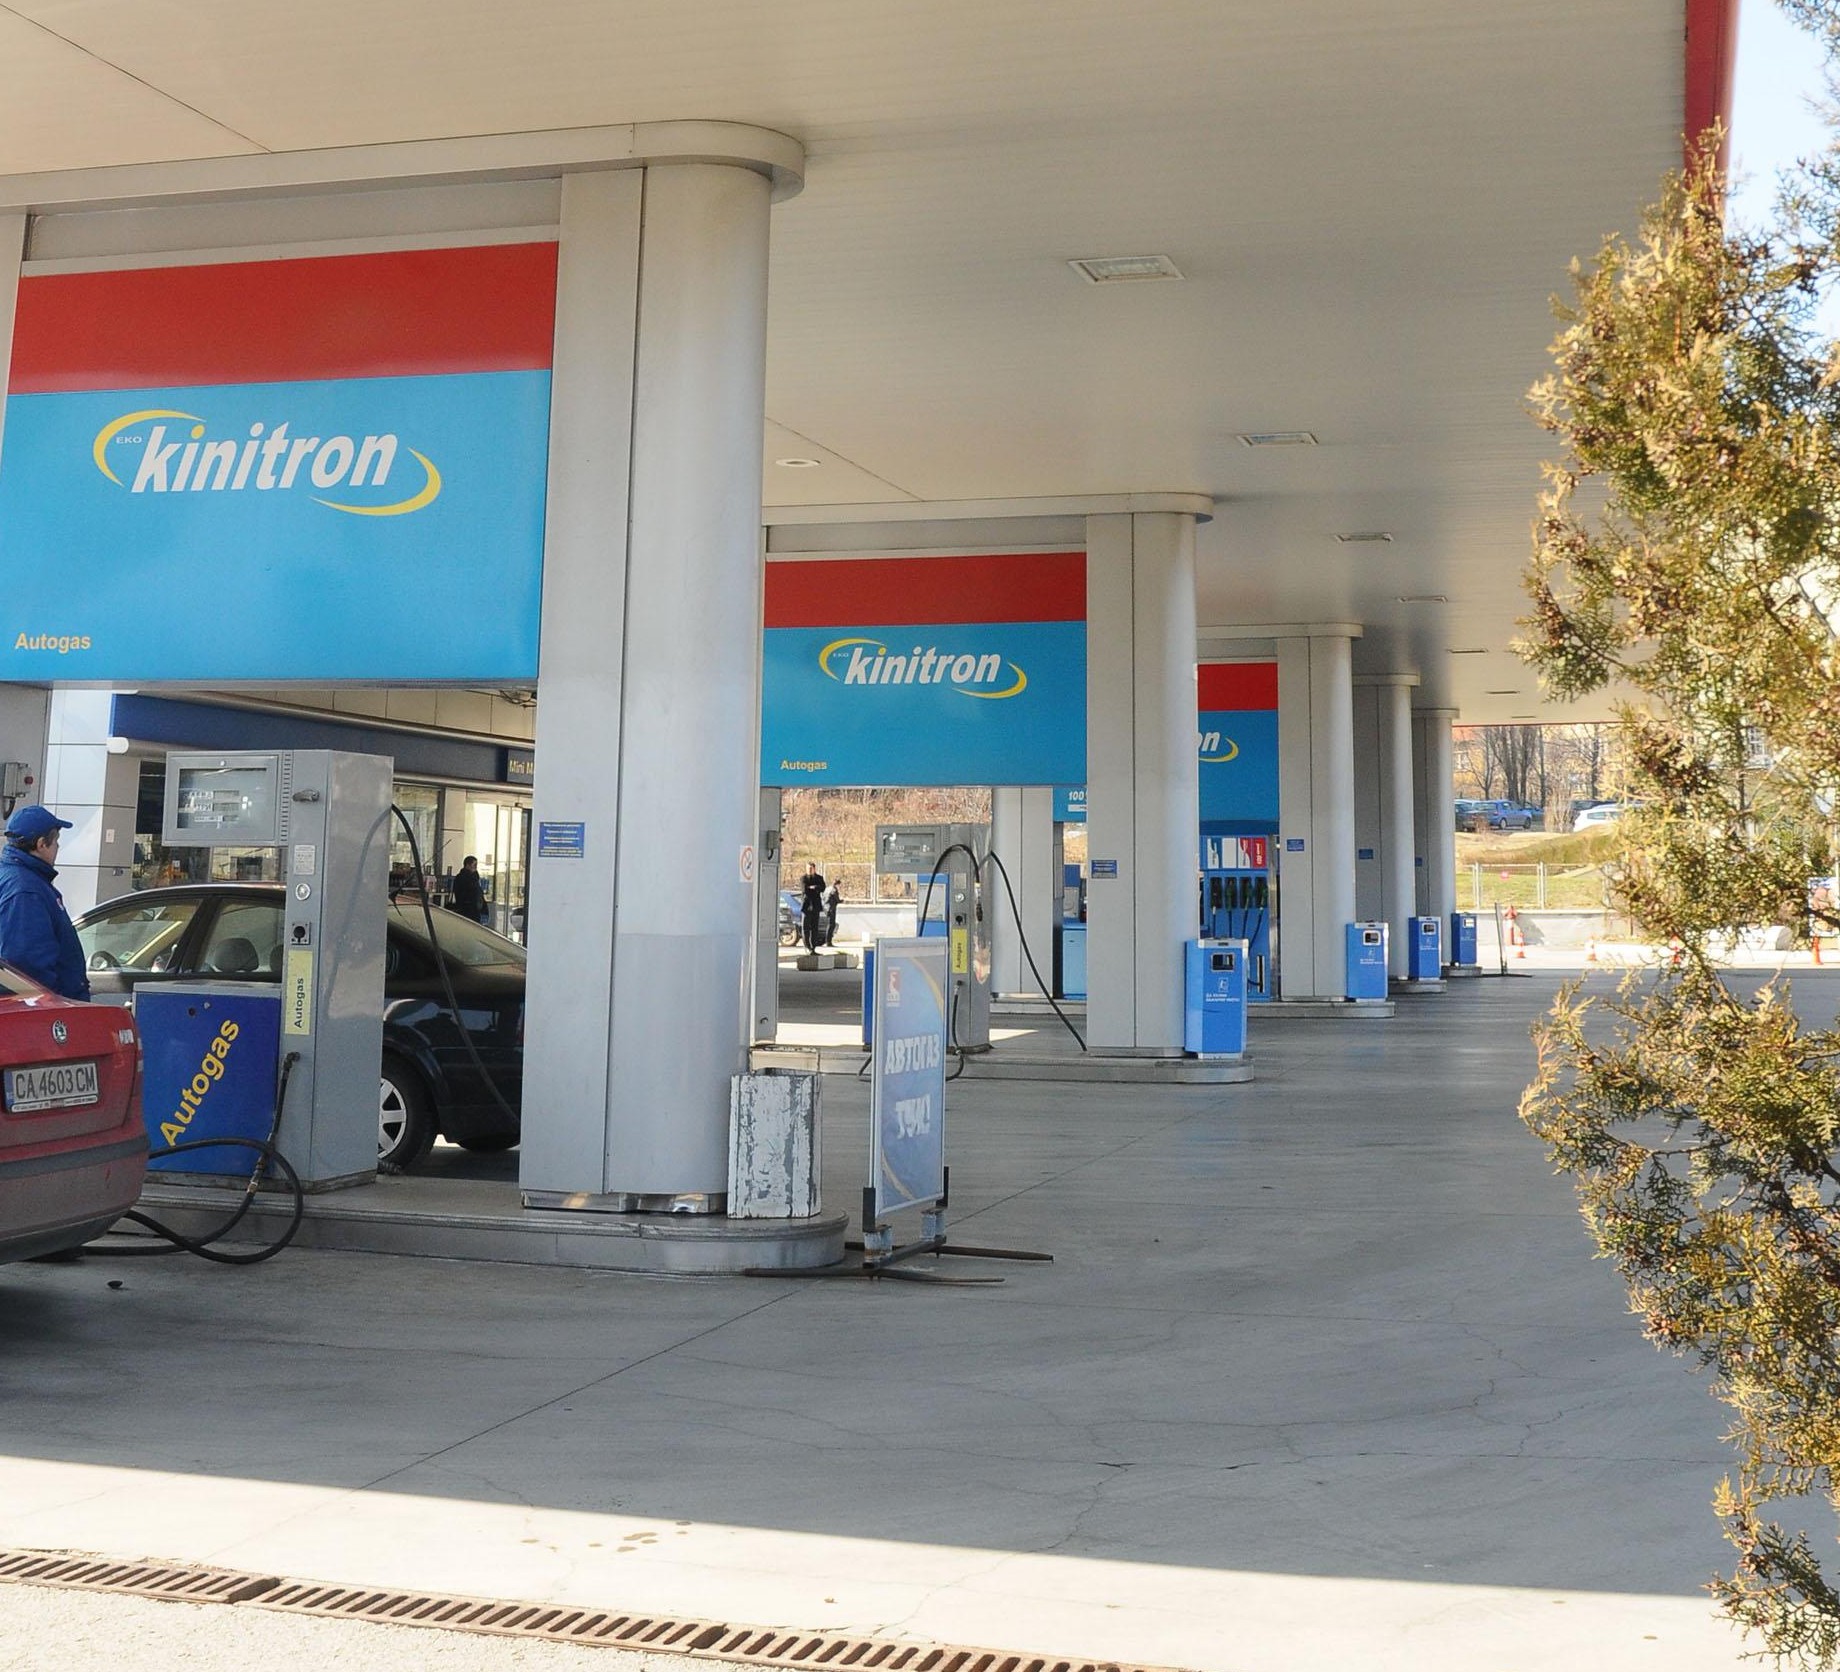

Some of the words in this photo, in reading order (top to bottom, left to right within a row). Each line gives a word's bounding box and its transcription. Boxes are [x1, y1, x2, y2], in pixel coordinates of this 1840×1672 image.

[115, 436, 143, 444] EKO
[131, 421, 398, 493] kinitron
[14, 632, 92, 654] Autogas
[844, 646, 1001, 685] kinitron
[509, 760, 525, 774] Mini
[780, 760, 828, 772] Autogas
[1068, 790, 1088, 801] 100
[955, 942, 963, 968] Autogas
[294, 977, 305, 1028] Autogas
[884, 1034, 940, 1075] АВТОГАЗ
[39, 1069, 74, 1097] 4603
[160, 1019, 240, 1147] Autogas
